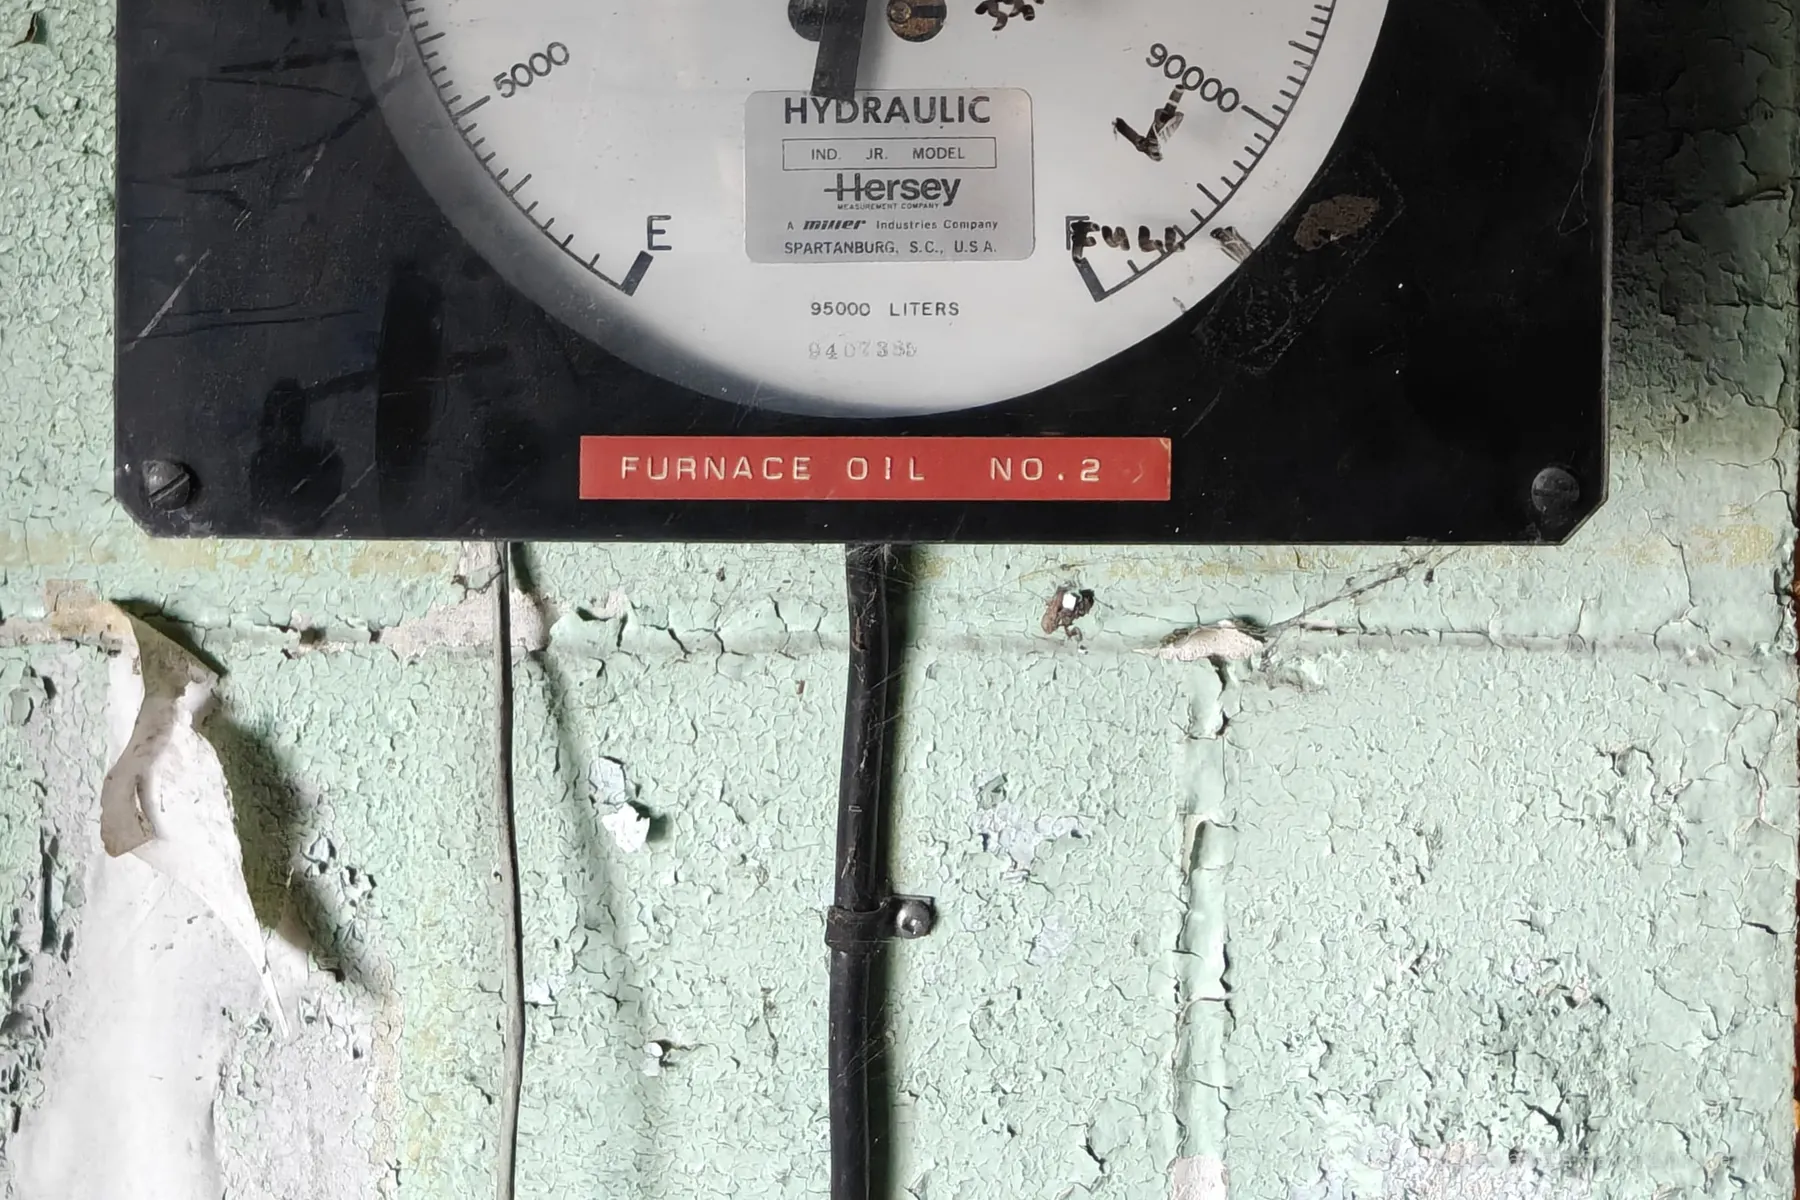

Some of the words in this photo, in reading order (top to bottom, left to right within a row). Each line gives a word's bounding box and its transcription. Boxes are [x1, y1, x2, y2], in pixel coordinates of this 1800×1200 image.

[493, 42, 570, 99] 5000
[1145, 43, 1240, 113] 90000
[784, 96, 991, 124] HYDRAULIC
[811, 148, 841, 161] IND.
[865, 148, 888, 160] JR.
[912, 147, 965, 159] MODEL
[824, 173, 961, 207] Hersey
[647, 214, 673, 251] E
[787, 222, 794, 230] A
[876, 219, 937, 230] Industries
[943, 219, 998, 232] Company
[811, 302, 871, 316] 95000
[889, 302, 960, 316] LITERS
[620, 457, 812, 481] FURNACE
[846, 457, 926, 481] OIL
